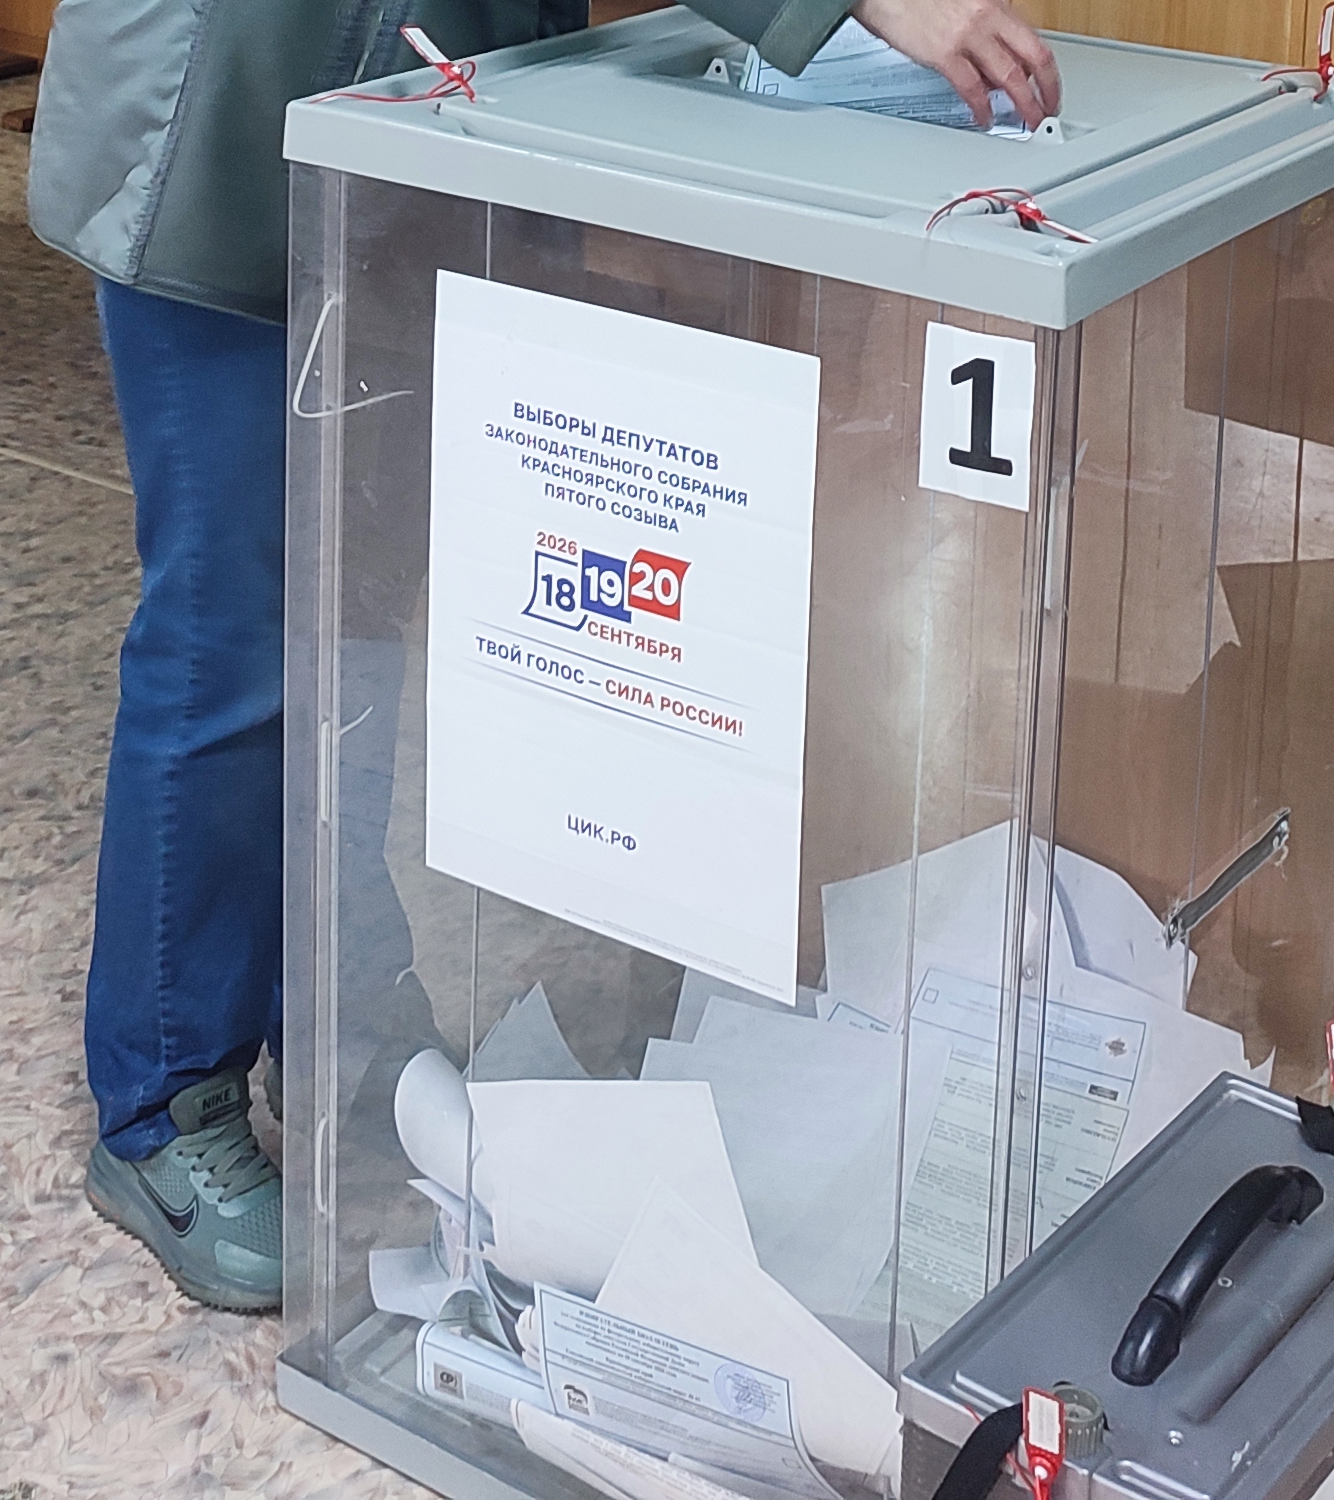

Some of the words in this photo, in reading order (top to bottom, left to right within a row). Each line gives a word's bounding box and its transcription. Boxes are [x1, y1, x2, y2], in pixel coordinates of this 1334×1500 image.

[514, 402, 596, 438] ВЫБОРЫ
[601, 426, 718, 470] ДЕПУТАТОВ
[948, 356, 1013, 477] 1
[485, 423, 652, 480] ЗАКОНОДАТЕЛЬНОГО
[657, 470, 748, 507] СОБРАНИЯ
[521, 454, 658, 503] КРАСНОЯРСКОГО
[663, 493, 706, 518] КРАЯ
[544, 483, 606, 511] ПЯТОГО
[611, 502, 679, 533] СОЗЫВА
[536, 531, 578, 556] 2026
[541, 573, 576, 612] 18
[584, 565, 624, 607] 19
[630, 561, 680, 606] 20
[587, 620, 682, 663] СЕНТЯБРЯ
[476, 636, 522, 665] ТВОЙ
[527, 653, 584, 684] ГОЛОС
[605, 679, 655, 709] СИЛА
[660, 696, 743, 737] РОССИИ!
[567, 814, 637, 851] ЦИК.РФ
[202, 1086, 232, 1112] NIKE
